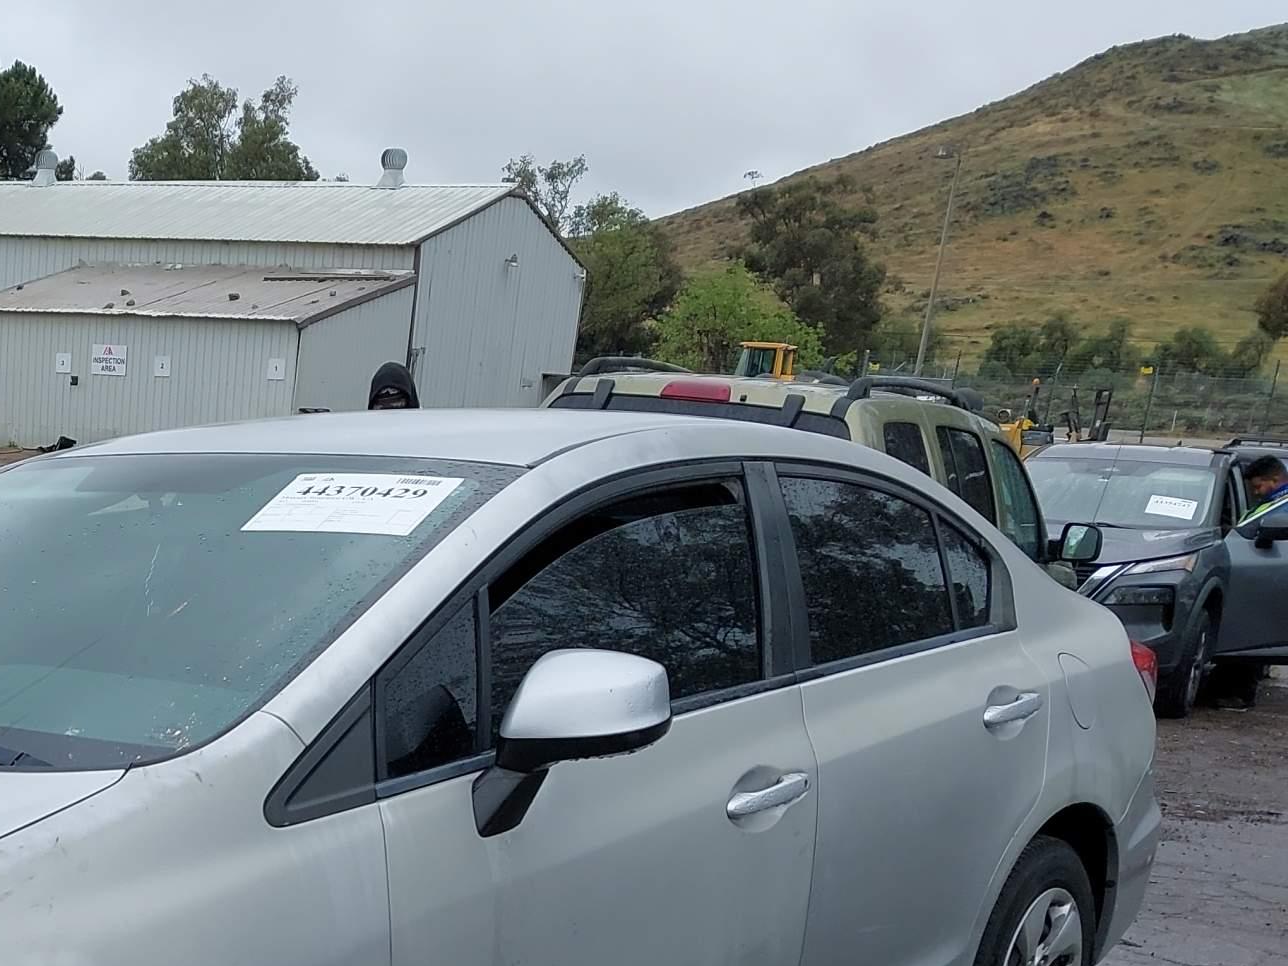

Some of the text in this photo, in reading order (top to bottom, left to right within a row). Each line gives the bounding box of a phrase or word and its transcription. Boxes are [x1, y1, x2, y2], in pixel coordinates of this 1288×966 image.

[92, 356, 126, 365] INSPECTION
[100, 365, 117, 373] AREA
[296, 485, 429, 499] 44370429
